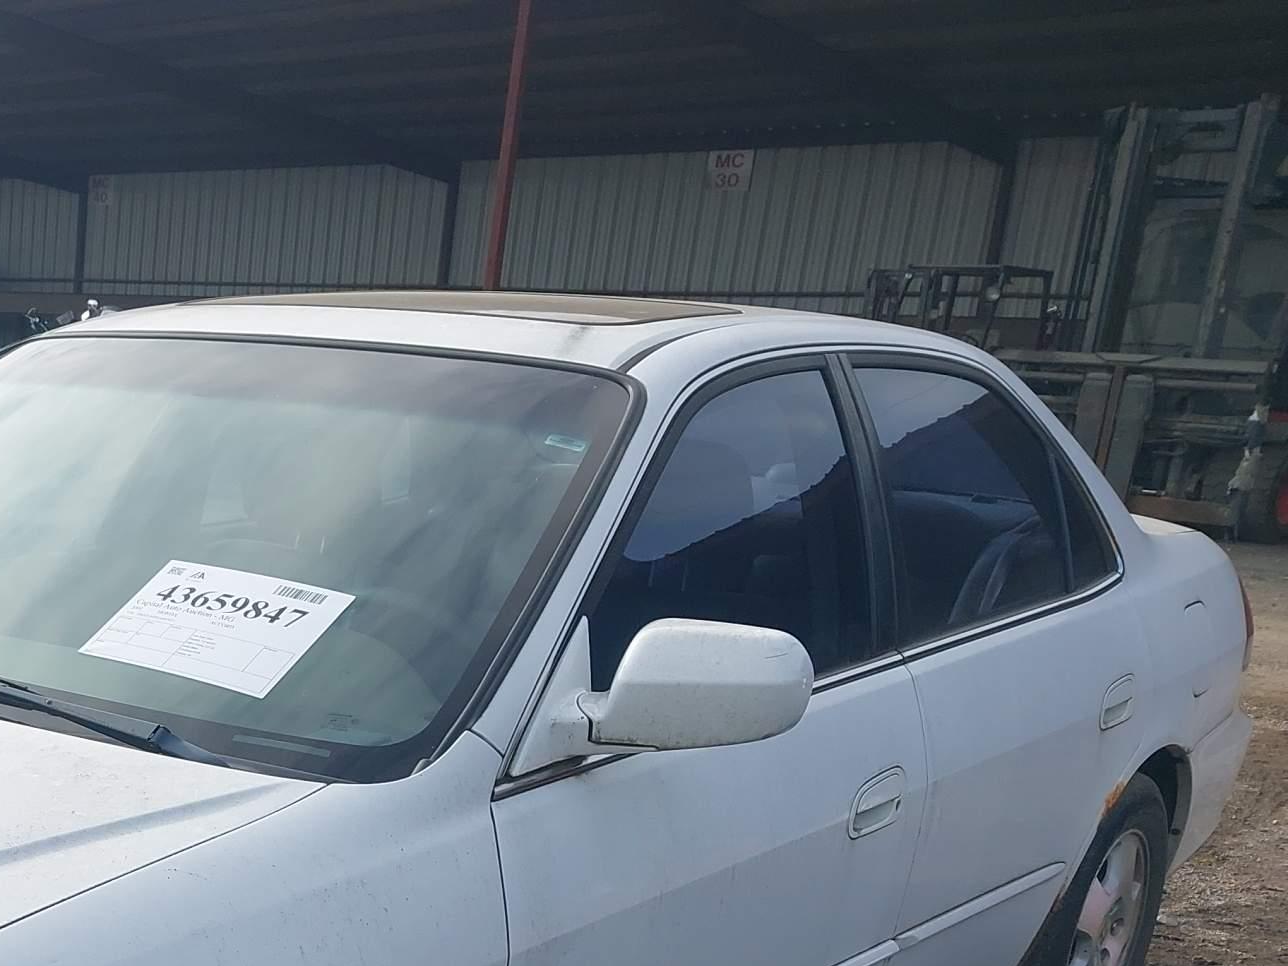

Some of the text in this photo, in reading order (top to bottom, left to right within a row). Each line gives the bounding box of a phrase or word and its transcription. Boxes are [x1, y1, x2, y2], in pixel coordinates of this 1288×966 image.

[715, 153, 745, 168] MC
[715, 172, 740, 188] 30
[156, 584, 310, 628] 43659847
